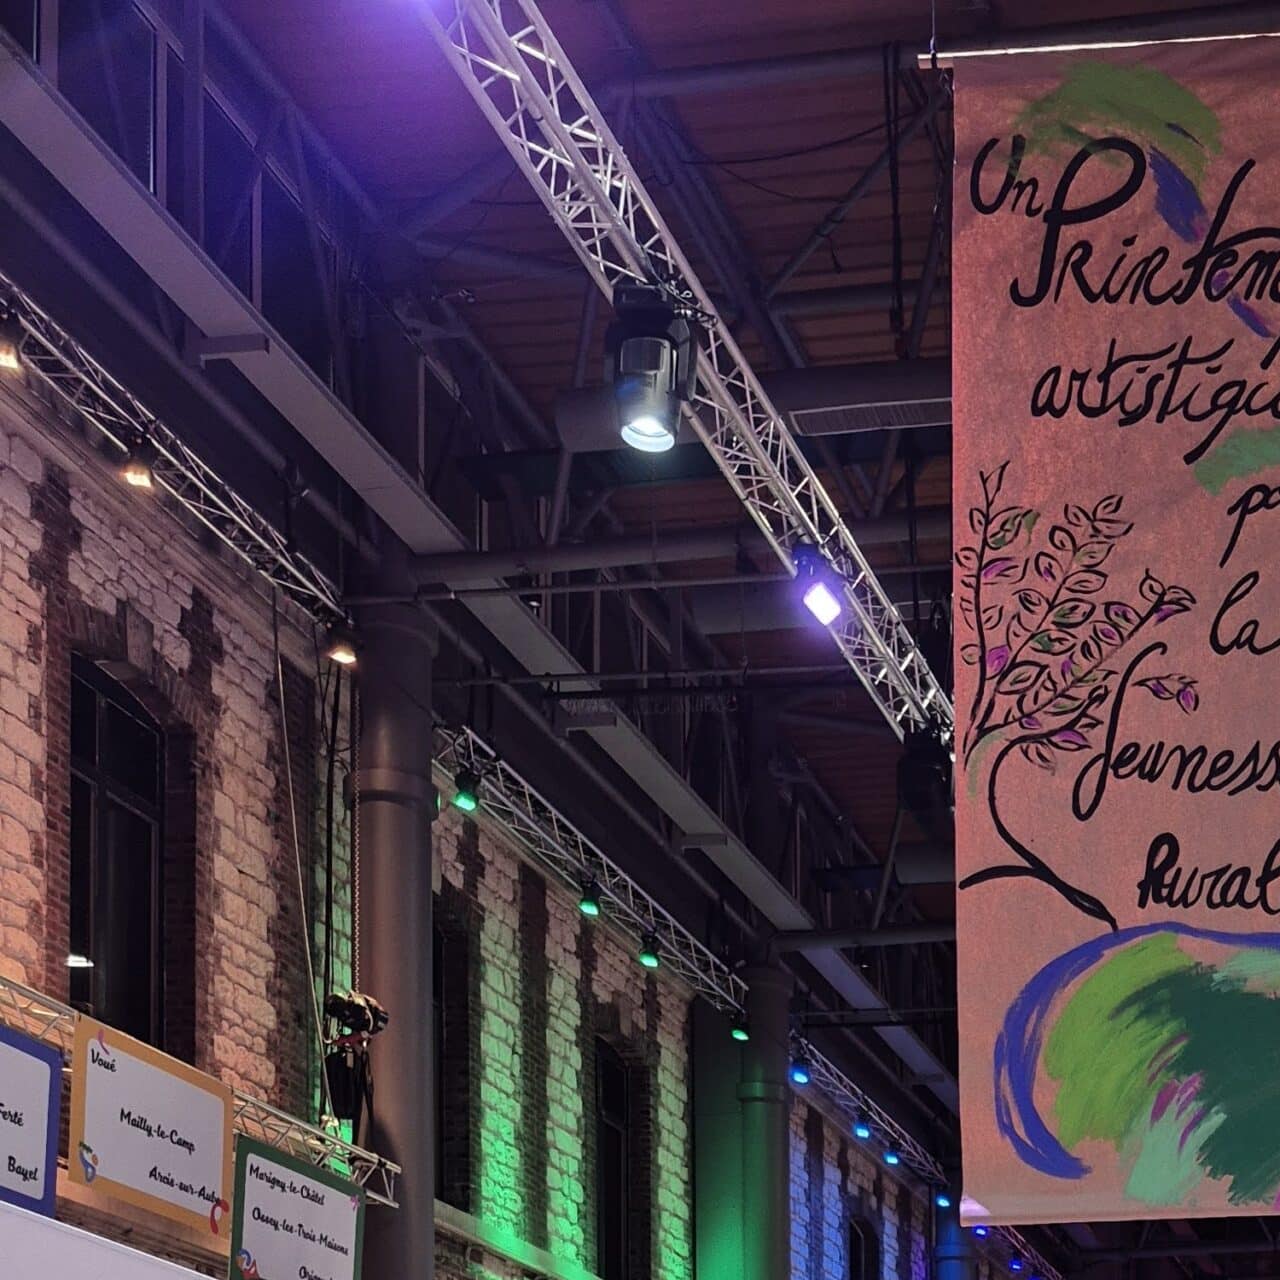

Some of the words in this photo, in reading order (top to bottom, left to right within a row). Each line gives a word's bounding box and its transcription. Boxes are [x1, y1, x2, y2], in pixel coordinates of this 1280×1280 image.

[970, 134, 1043, 217] Un
[91, 1047, 117, 1073] Voué
[0, 1102, 24, 1127] erté
[119, 1107, 196, 1156] Mailly-le-Camp
[7, 1155, 39, 1182] Bayel
